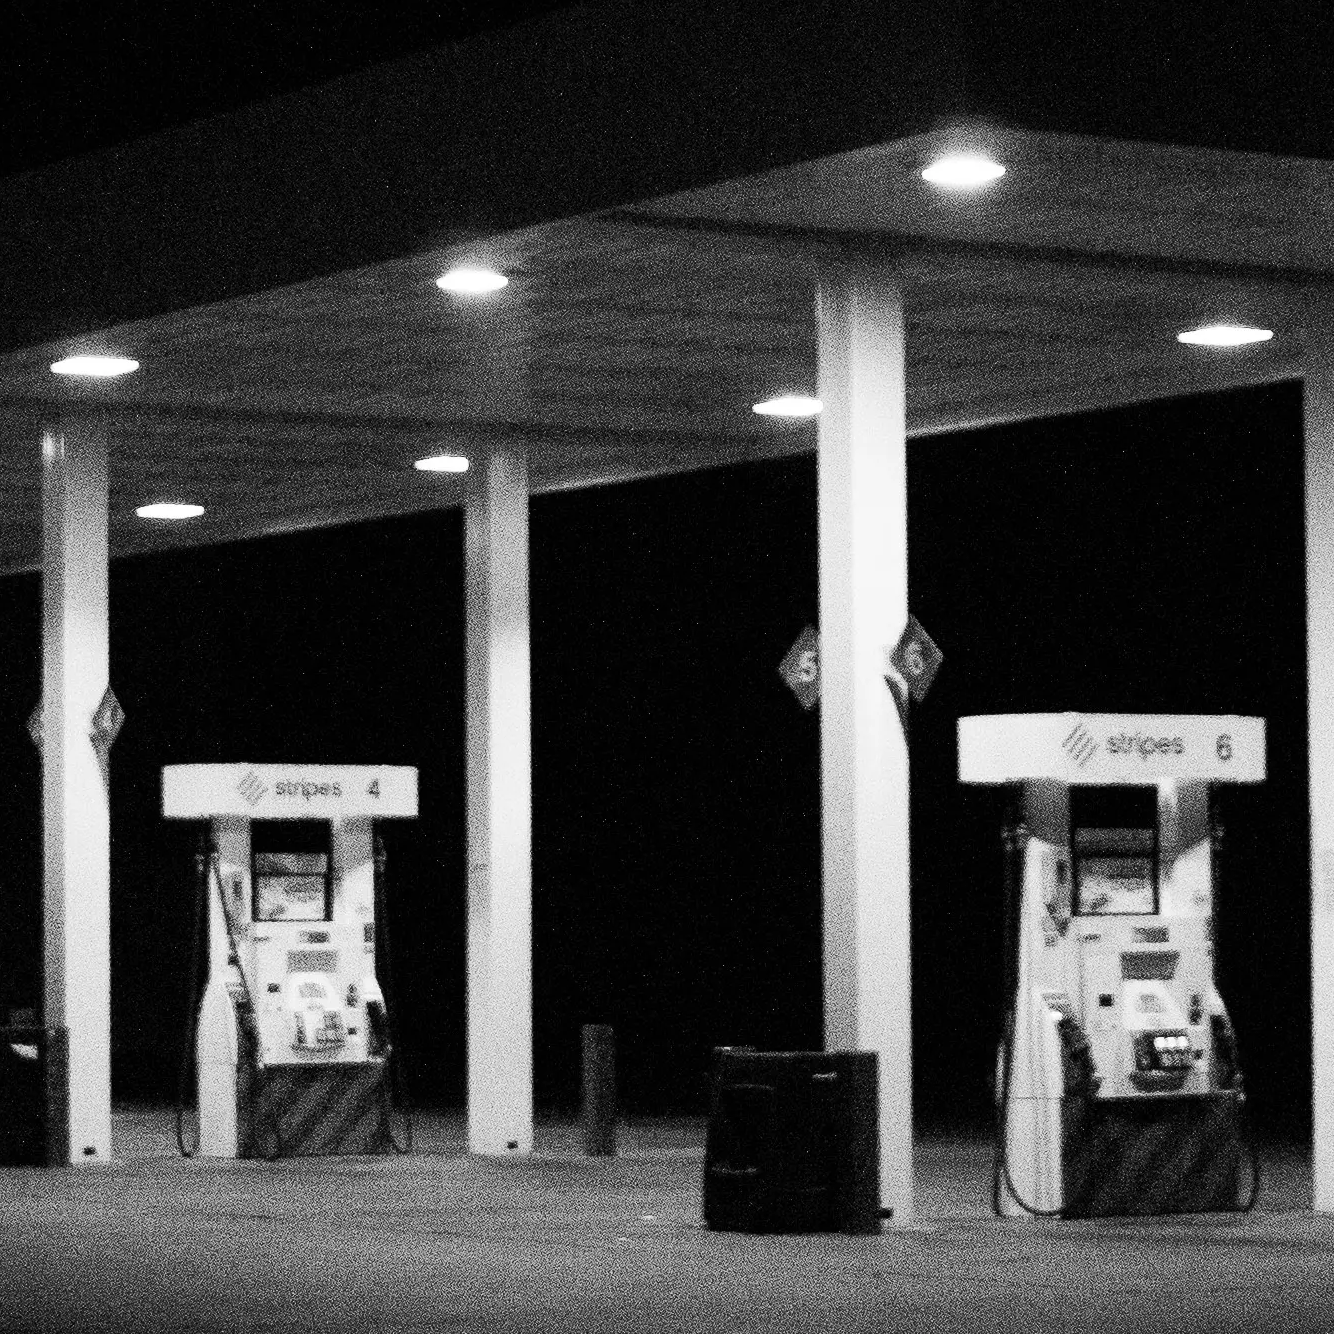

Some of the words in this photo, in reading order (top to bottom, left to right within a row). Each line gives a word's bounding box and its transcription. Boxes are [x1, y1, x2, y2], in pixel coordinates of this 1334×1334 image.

[799, 650, 817, 682] 5
[906, 641, 924, 675] 6
[1108, 733, 1184, 761] stripes
[1216, 733, 1232, 761] 6
[276, 779, 342, 801] stripes
[367, 778, 380, 798] 4
